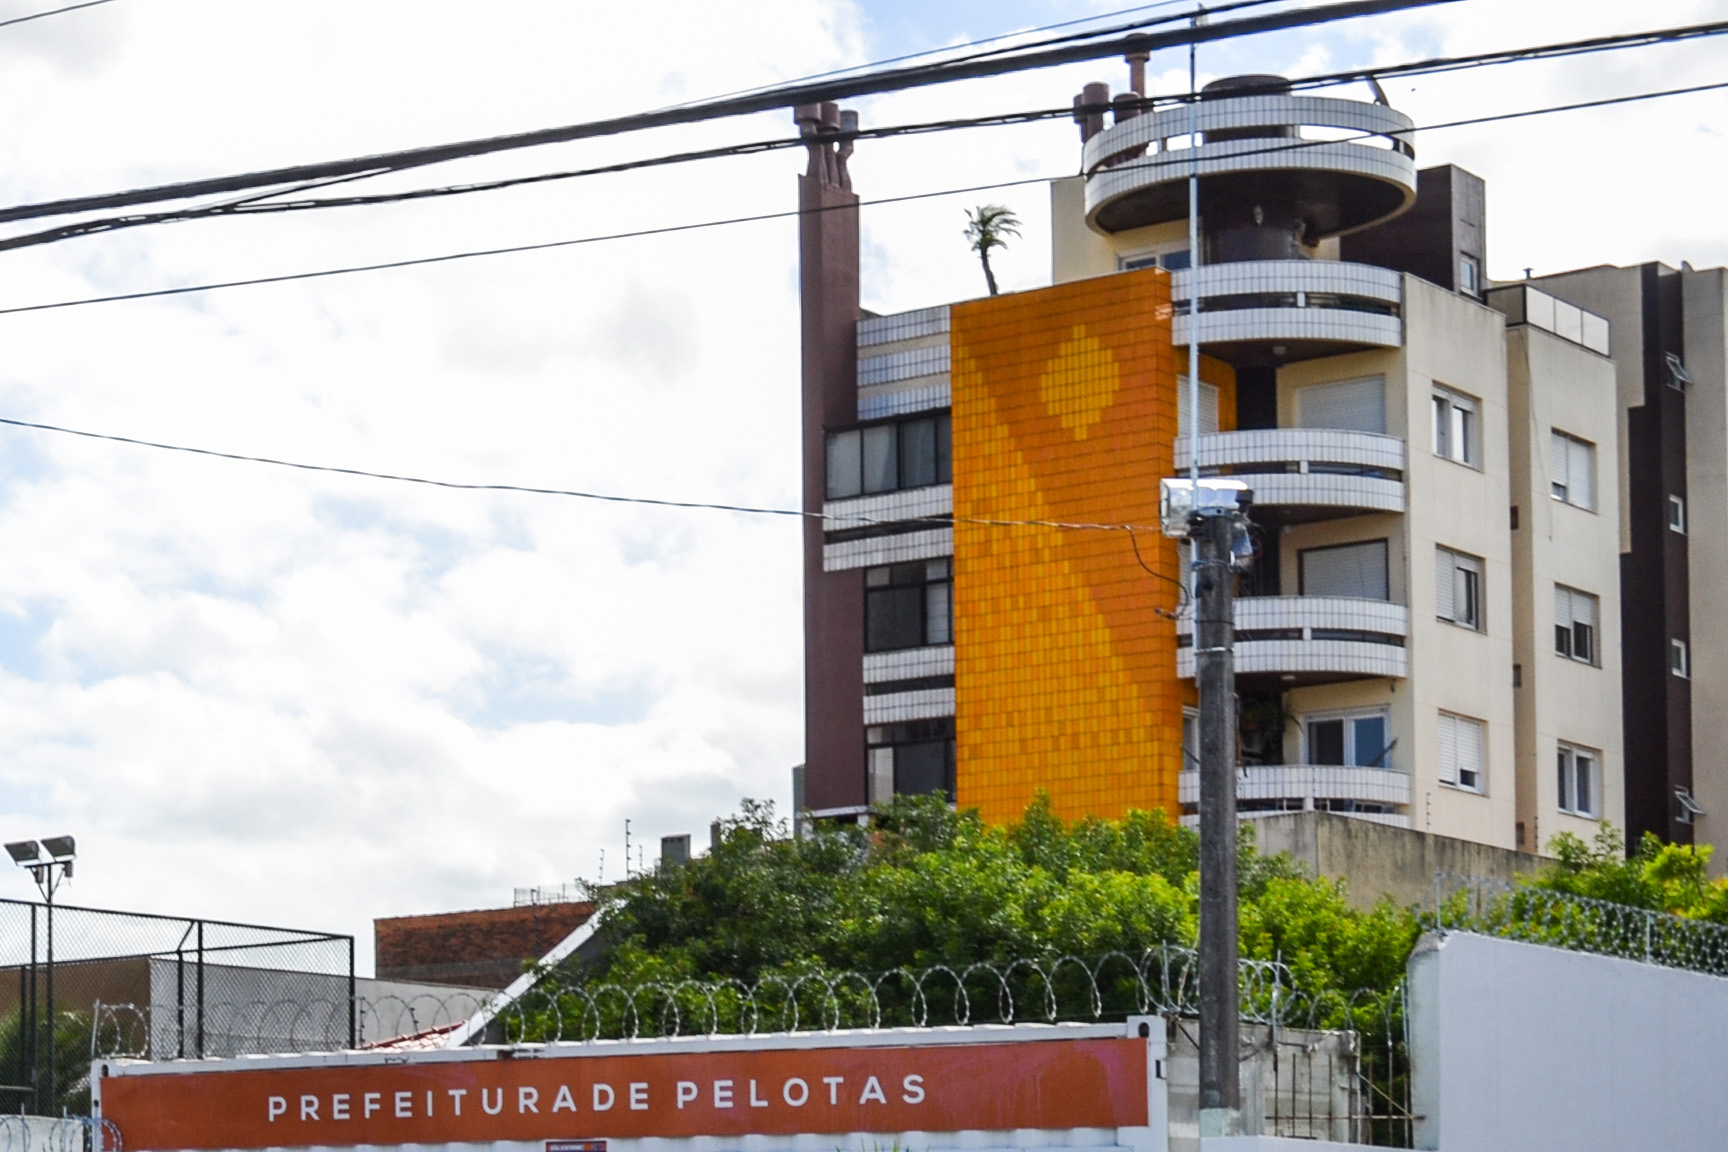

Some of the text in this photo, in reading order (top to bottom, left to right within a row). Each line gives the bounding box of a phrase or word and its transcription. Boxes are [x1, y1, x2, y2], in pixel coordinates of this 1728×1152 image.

[268, 1074, 926, 1122] PREFEITURA DE PELOTAS
